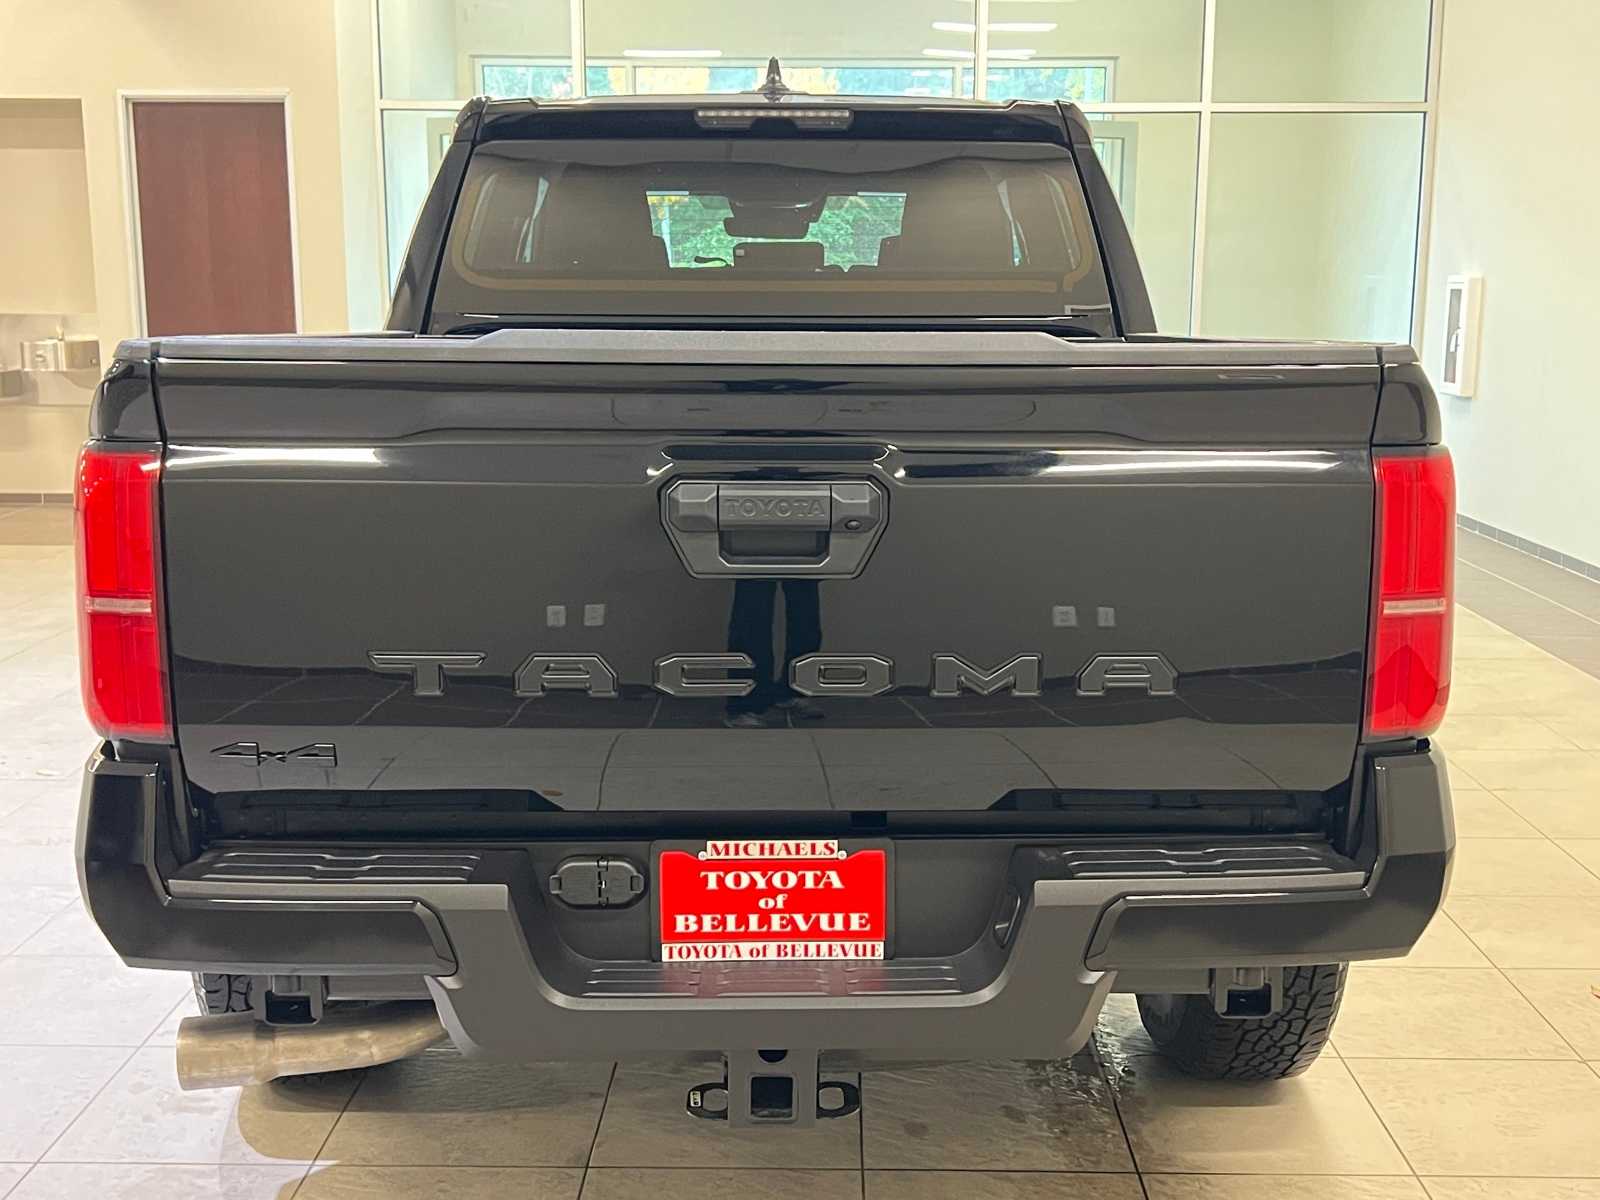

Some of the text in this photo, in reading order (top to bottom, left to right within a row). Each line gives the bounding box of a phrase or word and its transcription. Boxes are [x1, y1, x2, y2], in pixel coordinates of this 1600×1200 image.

[724, 499, 826, 518] TOYOTA
[367, 651, 1179, 698] TACOMA
[209, 741, 338, 768] 4x4
[709, 841, 836, 857] MICHAELS
[699, 870, 845, 890] TOYOTA
[757, 893, 789, 910] of
[673, 912, 871, 934] BELLEVUE
[664, 942, 882, 960] TOYOTA of BELLEVUE
